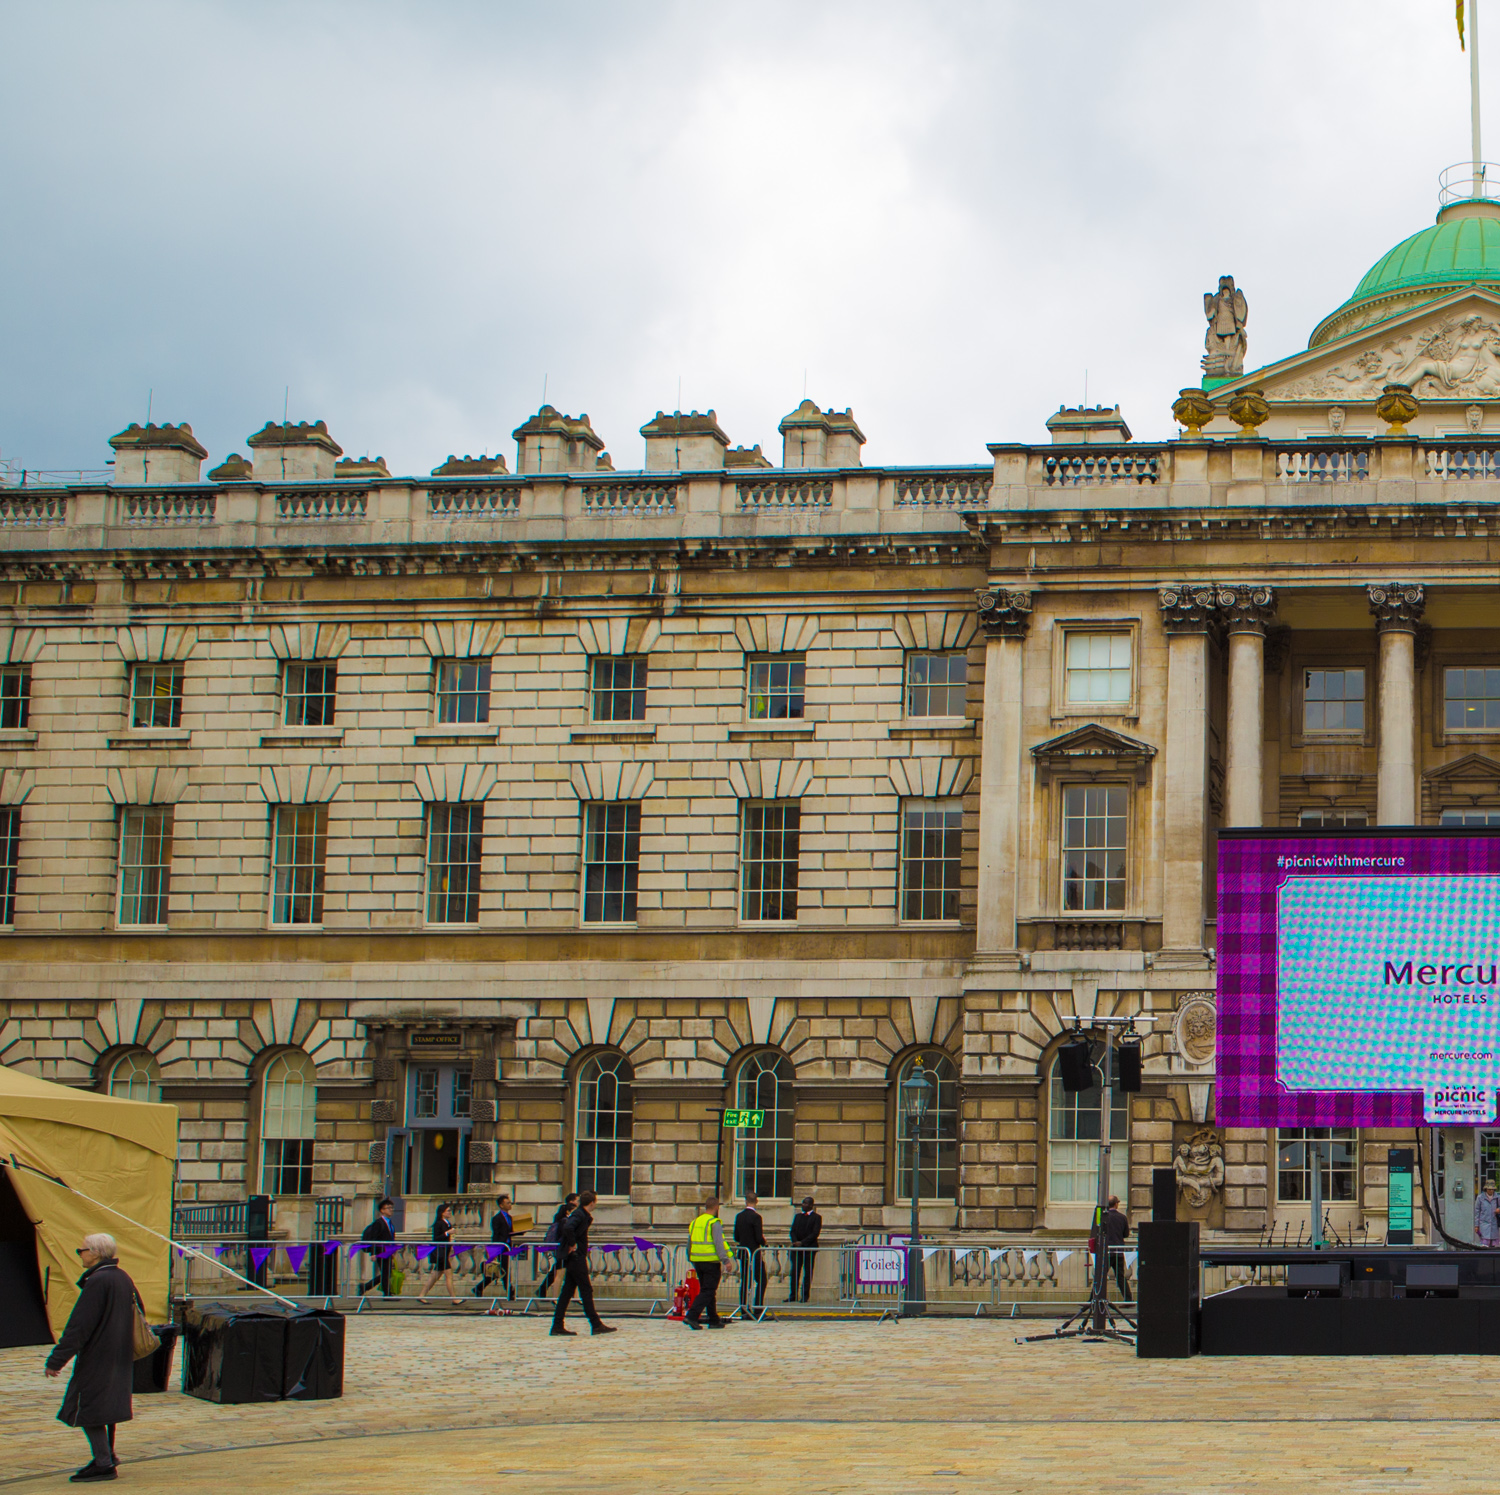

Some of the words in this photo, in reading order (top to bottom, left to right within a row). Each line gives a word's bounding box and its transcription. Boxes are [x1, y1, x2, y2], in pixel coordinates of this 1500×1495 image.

[1277, 855, 1405, 869] #picnicwithmercure
[1433, 994, 1487, 1004] HOTELS
[1429, 1051, 1492, 1060] mercure.com
[1435, 1086, 1486, 1107] picnic
[863, 1259, 900, 1270] Toilets
